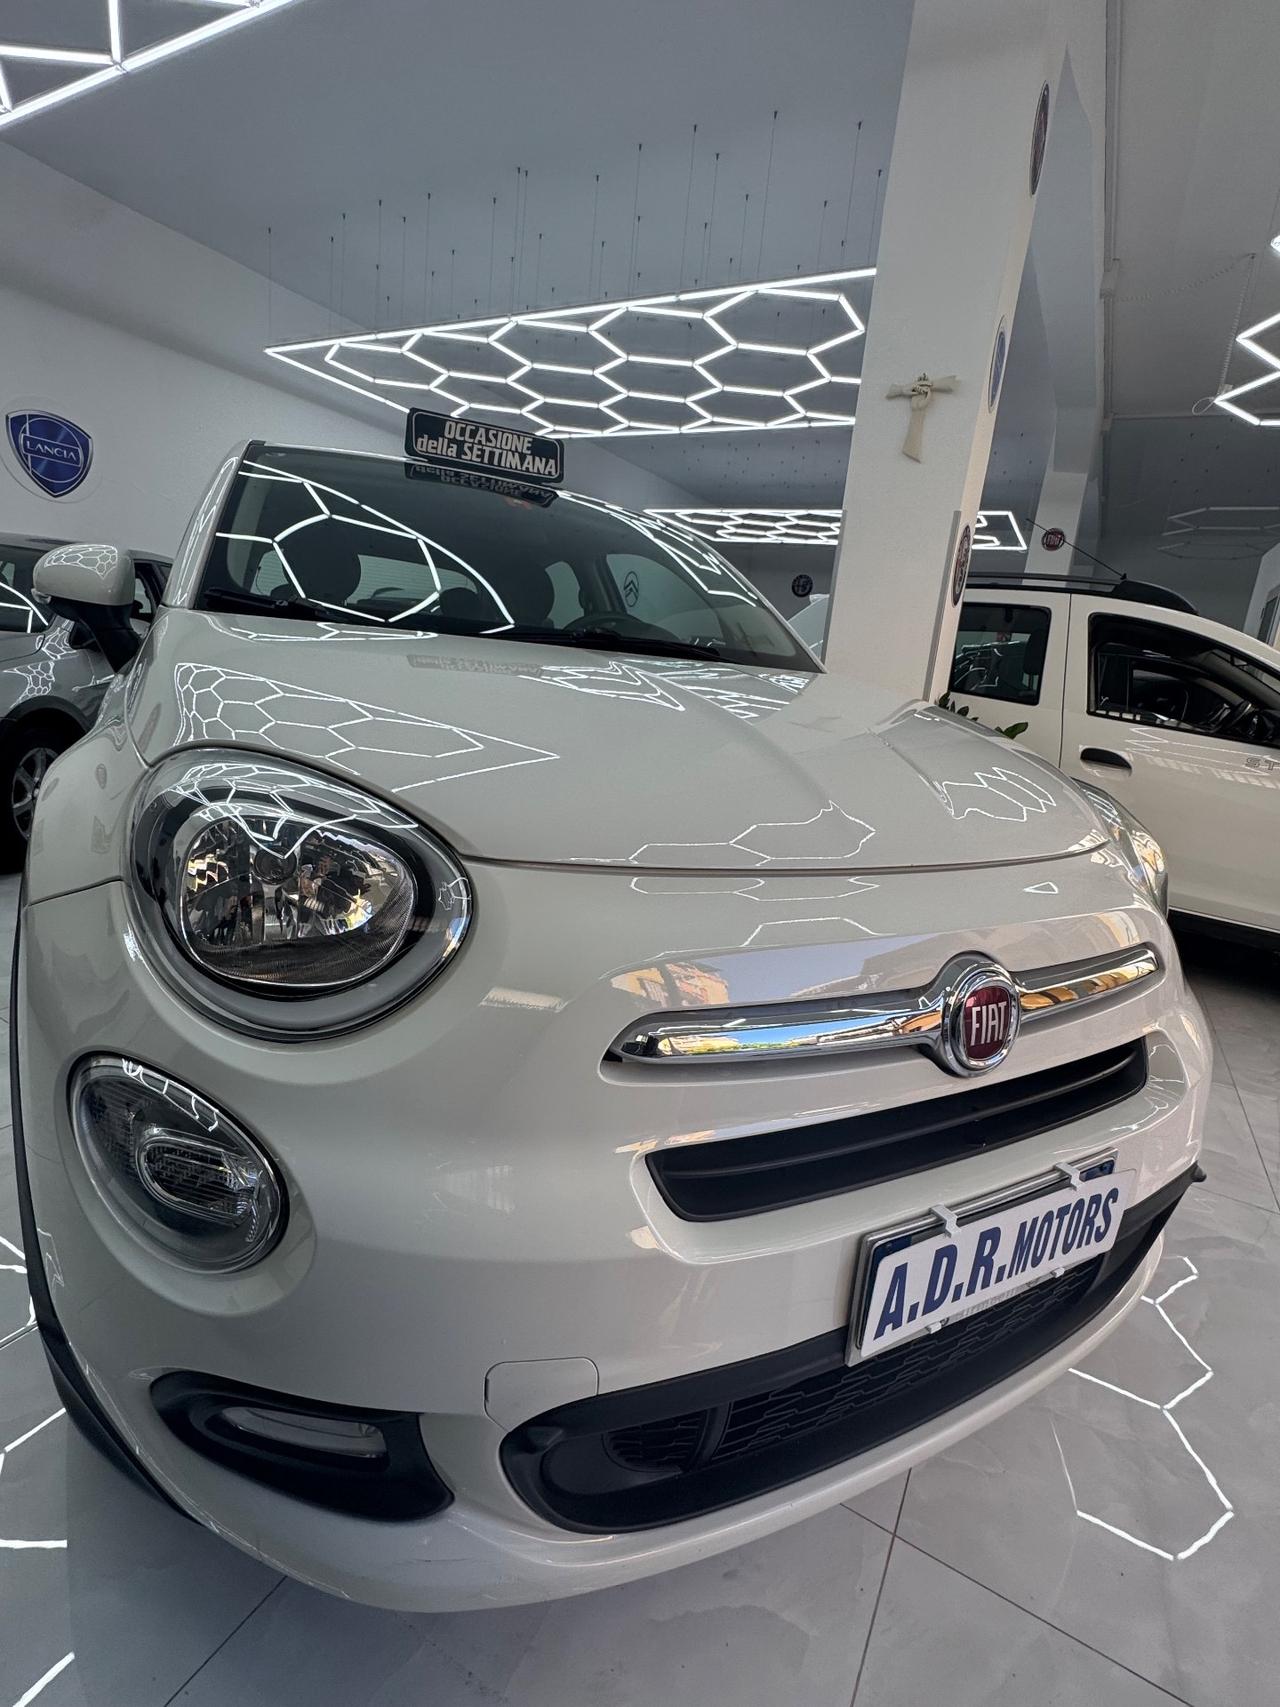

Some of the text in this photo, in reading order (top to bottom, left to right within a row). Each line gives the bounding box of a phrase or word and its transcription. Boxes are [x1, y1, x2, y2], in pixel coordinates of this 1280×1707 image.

[26, 440, 77, 461] LANCIA
[416, 434, 556, 476] della SETTIMANA
[444, 421, 533, 455] OCCASIONE
[970, 1001, 1008, 1047] FIAT
